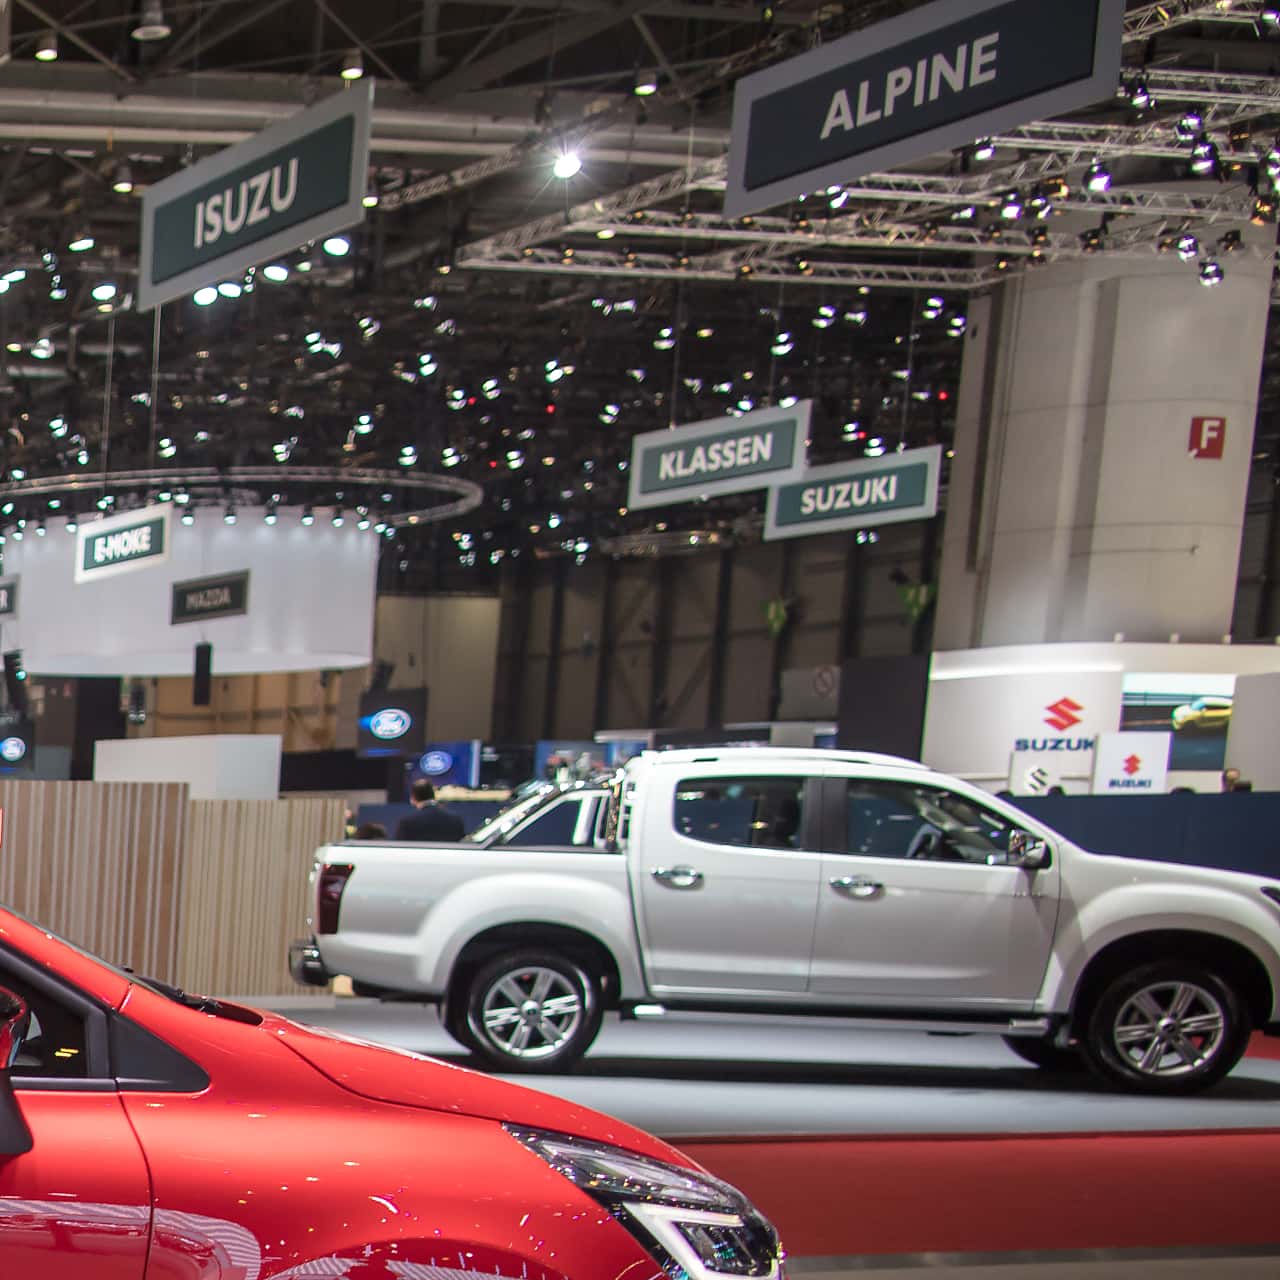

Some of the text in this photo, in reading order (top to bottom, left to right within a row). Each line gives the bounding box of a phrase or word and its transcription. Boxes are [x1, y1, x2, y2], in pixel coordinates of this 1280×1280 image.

[819, 31, 1000, 140] ALPINE
[193, 158, 299, 249] ISUZU
[1200, 420, 1220, 449] F
[659, 432, 773, 481] KLASSEN
[800, 475, 897, 515] SUZUKI
[93, 526, 152, 563] E-MOKE
[185, 586, 232, 610] MAZDA
